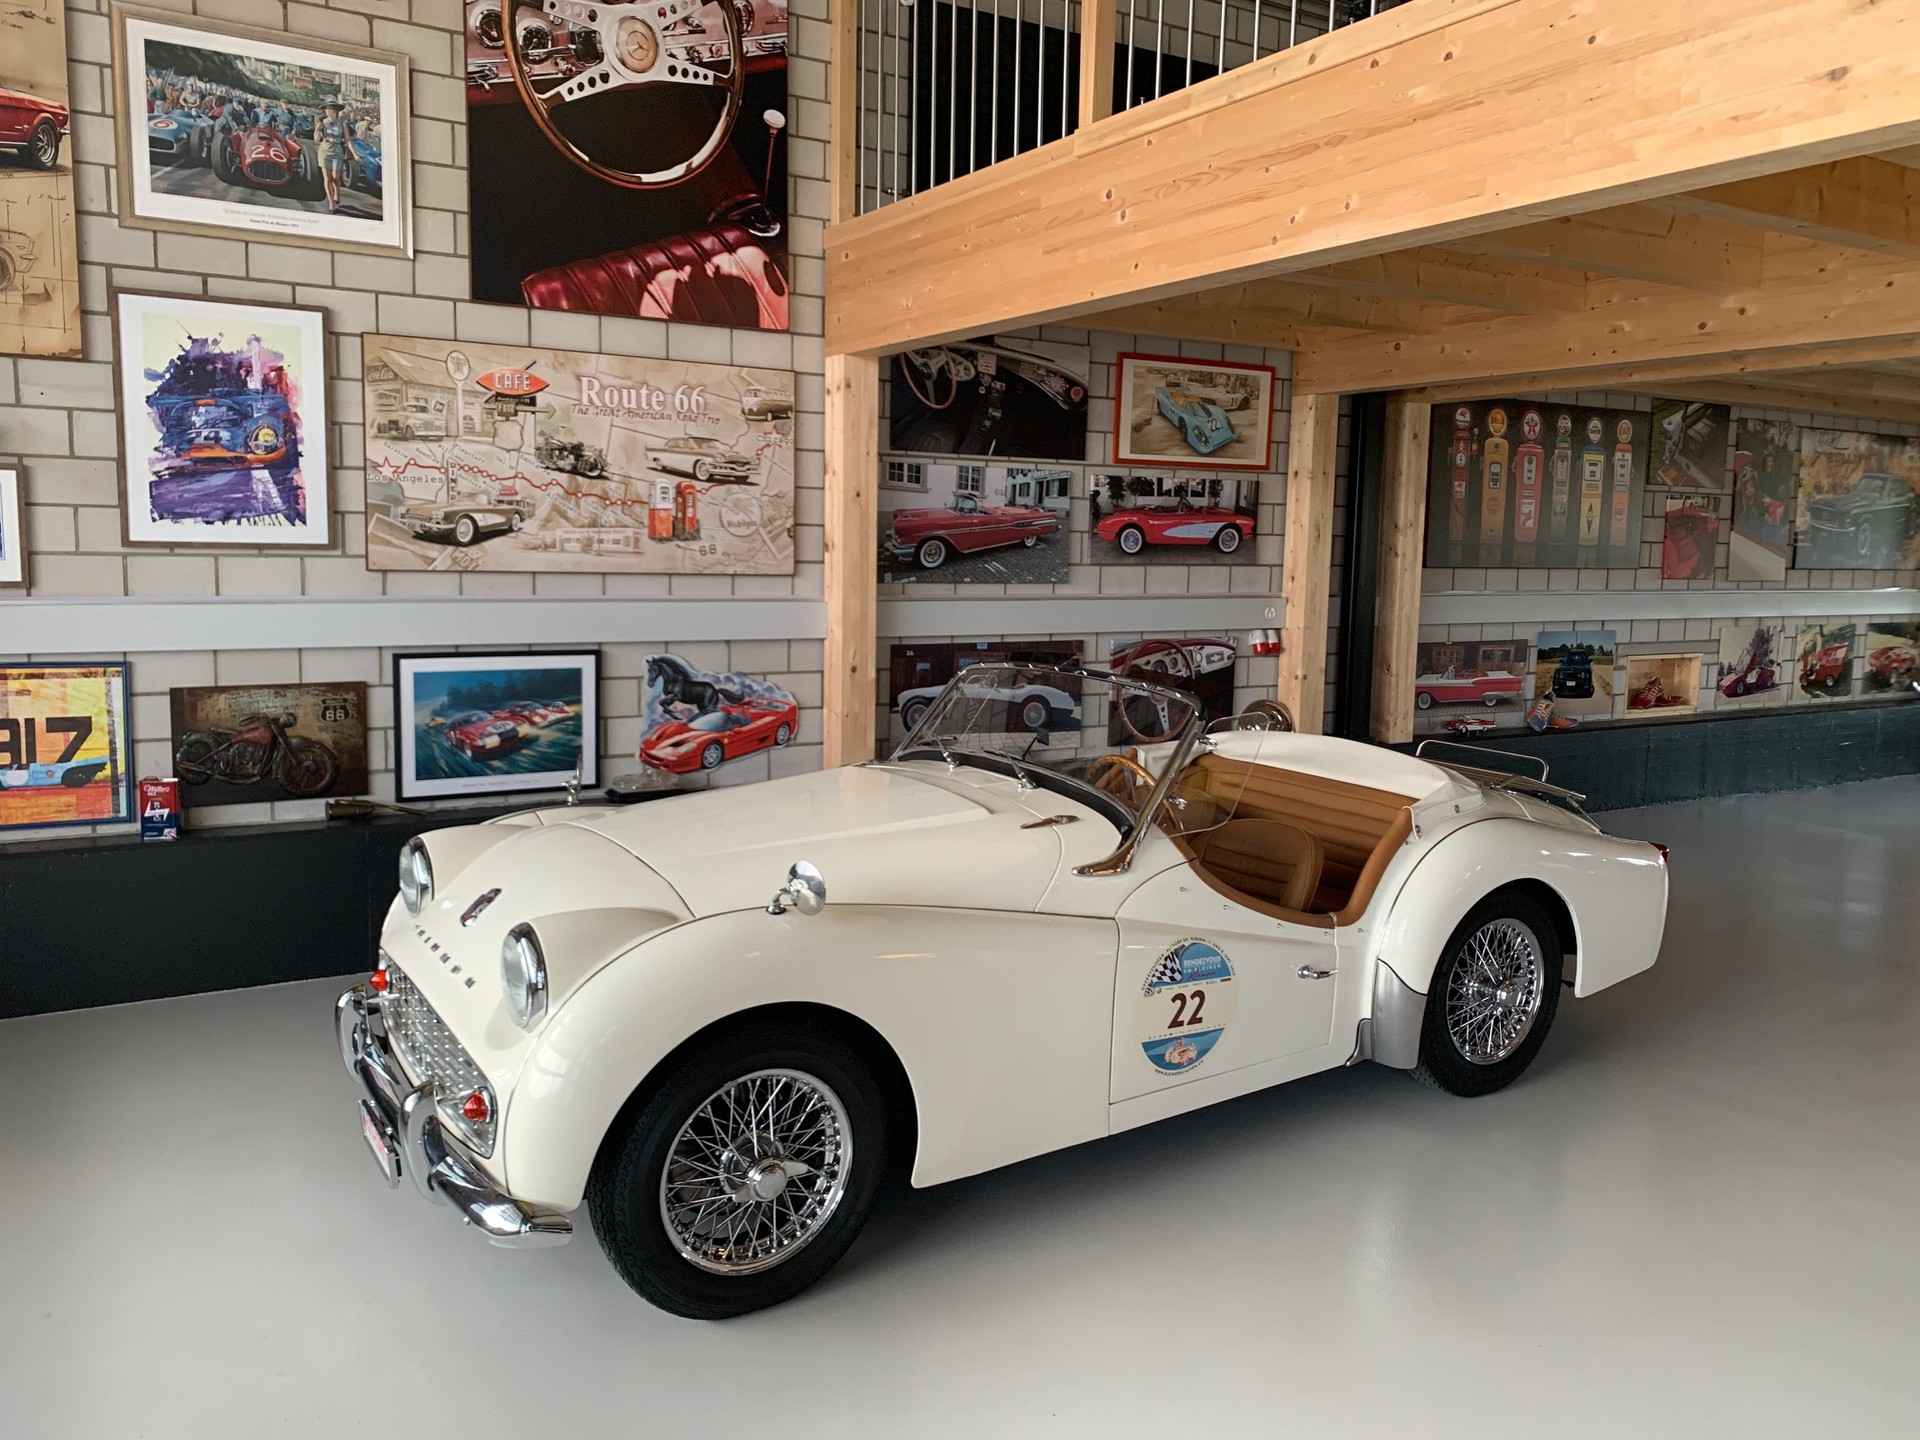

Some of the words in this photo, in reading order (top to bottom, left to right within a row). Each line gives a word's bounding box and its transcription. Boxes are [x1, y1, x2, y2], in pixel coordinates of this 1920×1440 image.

[579, 376, 665, 411] Route
[674, 384, 706, 414] 66
[571, 403, 589, 415] The
[590, 405, 621, 420] Great
[622, 408, 673, 422] American
[700, 412, 722, 429] Trip
[1207, 417, 1221, 432] 22
[367, 473, 388, 481] Los
[395, 474, 444, 484] Angeles
[699, 544, 717, 557] 66
[326, 709, 345, 721] 66
[1167, 990, 1206, 1029] 22
